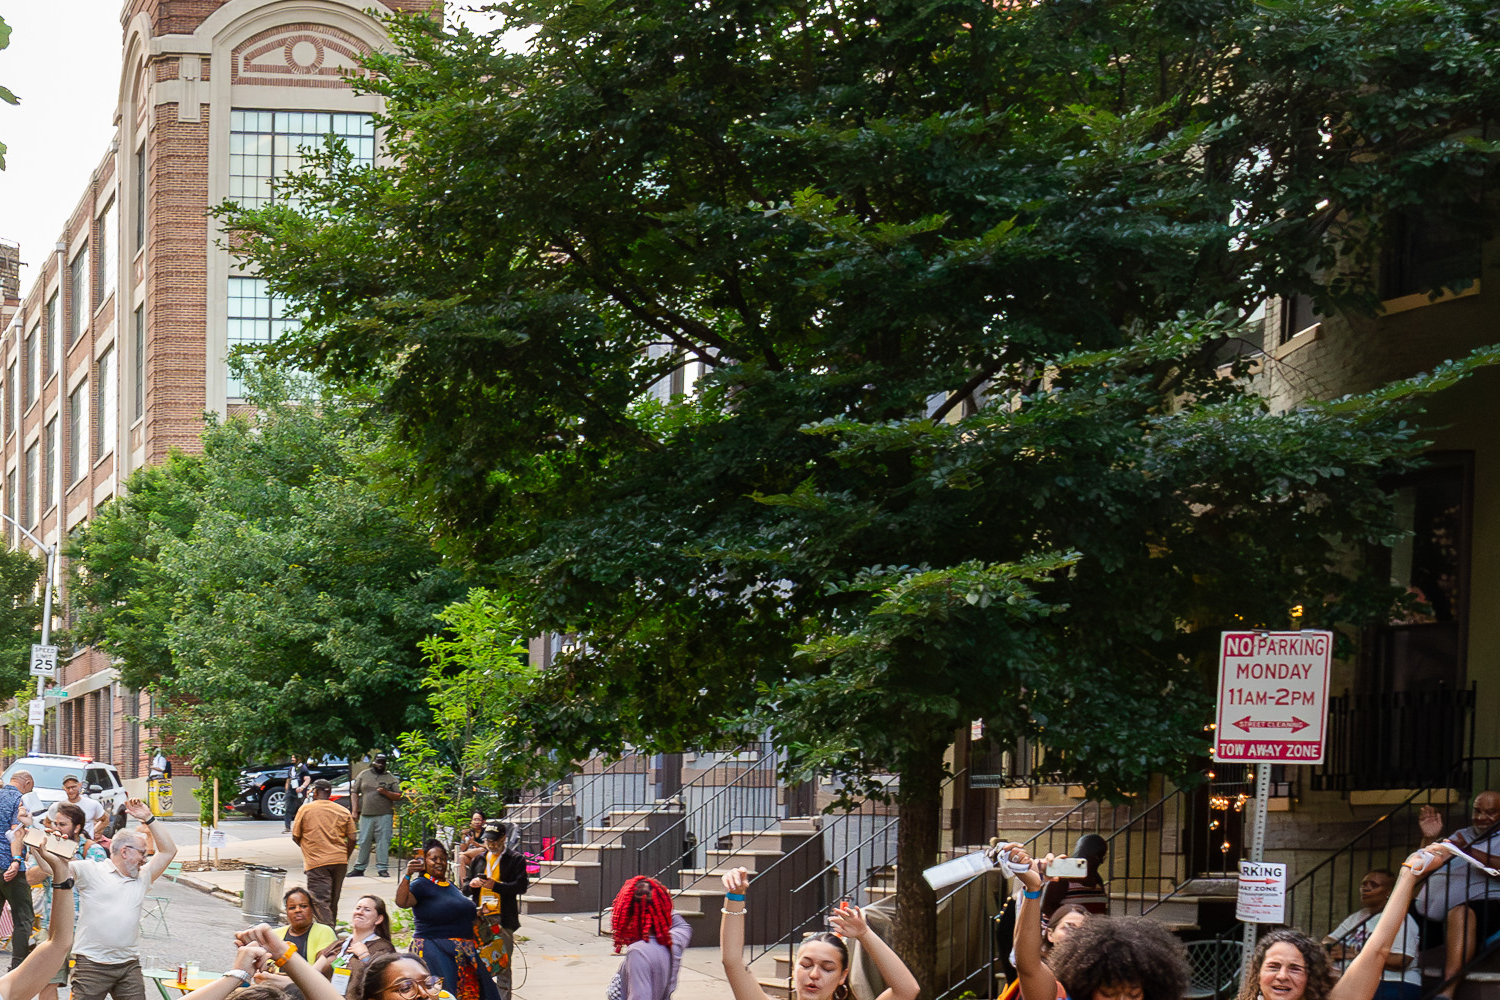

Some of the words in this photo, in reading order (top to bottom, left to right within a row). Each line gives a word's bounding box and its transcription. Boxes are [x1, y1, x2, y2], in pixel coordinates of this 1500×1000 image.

[35, 646, 55, 654] SPEED
[1226, 637, 1252, 655] NO
[1257, 638, 1325, 656] PARKING
[34, 659, 53, 671] 25
[1236, 663, 1313, 679] MONDAY
[1228, 687, 1316, 706] 11AM-2PM
[1239, 720, 1266, 728] STREET
[1267, 720, 1304, 728] CLEANING
[1219, 743, 1245, 756] TOW
[1247, 744, 1282, 757] AWAY
[1286, 744, 1320, 758] ZONE
